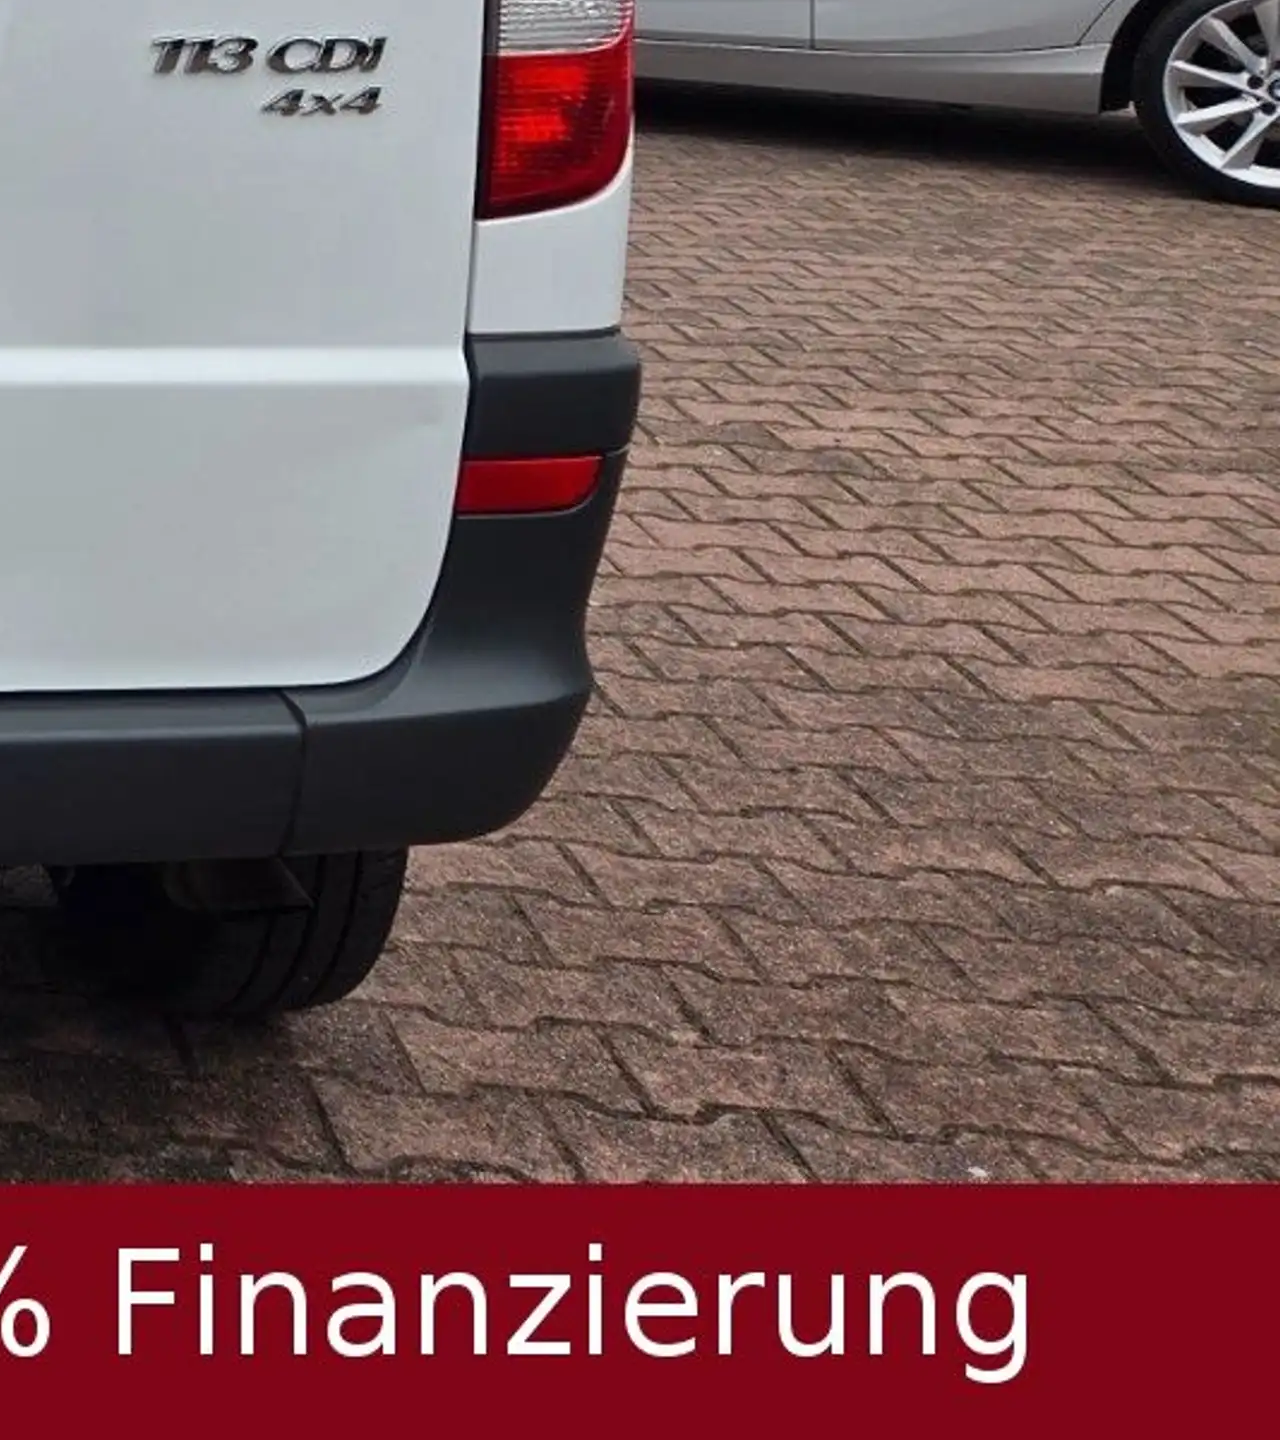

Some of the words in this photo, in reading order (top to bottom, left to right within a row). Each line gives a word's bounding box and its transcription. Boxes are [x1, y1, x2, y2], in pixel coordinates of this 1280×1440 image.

[152, 36, 259, 74] 113
[266, 36, 387, 74] CDI
[260, 87, 382, 117] 4x4
